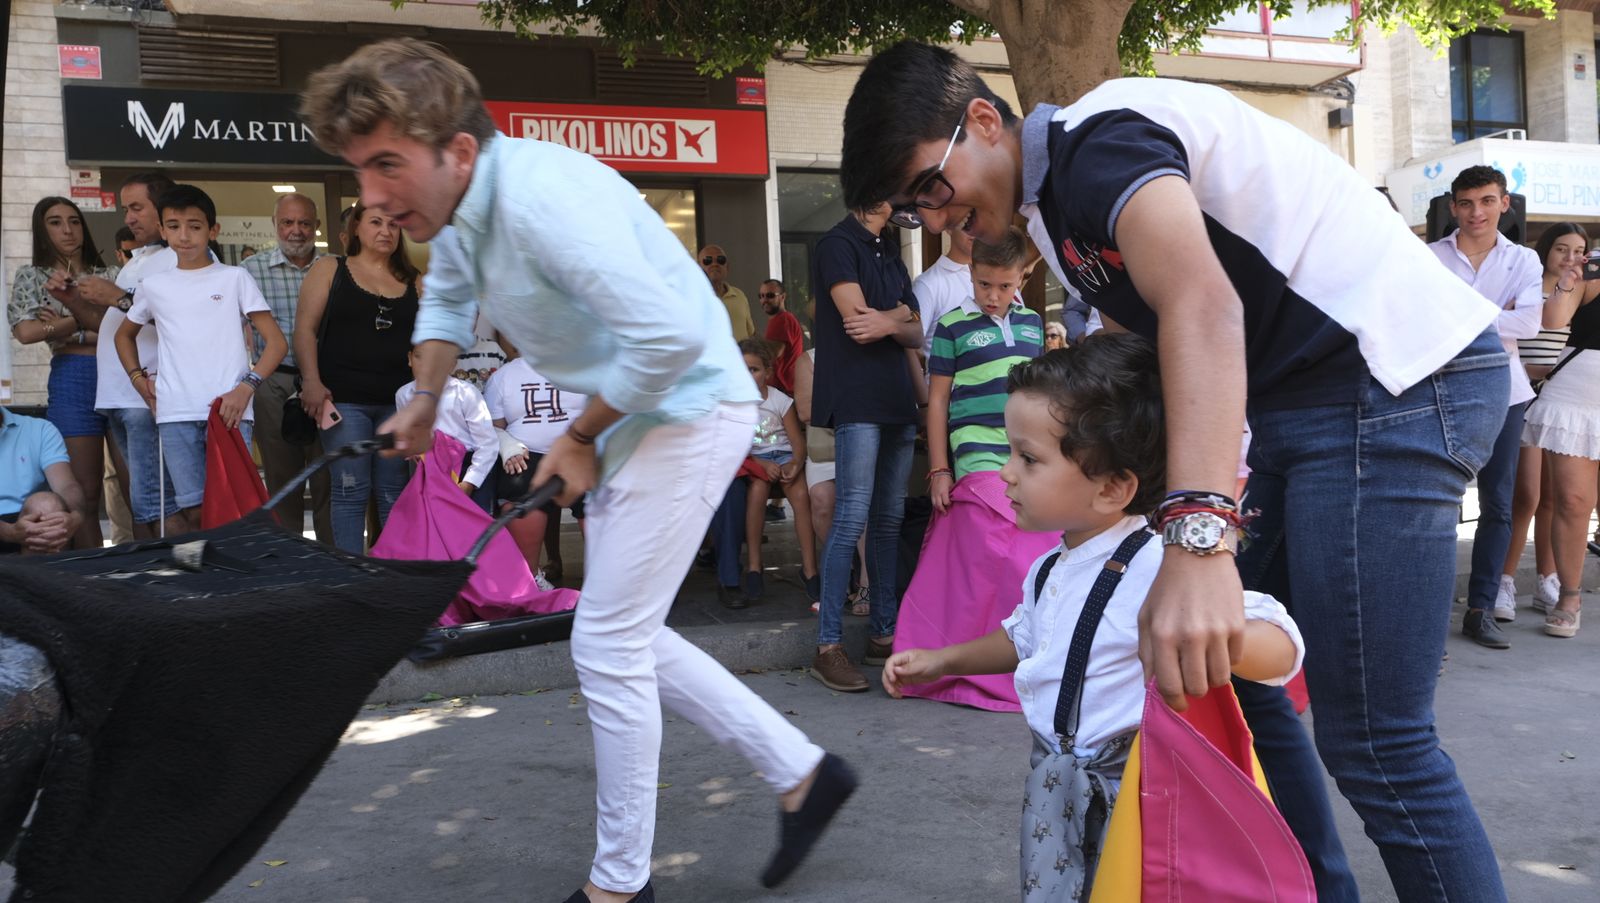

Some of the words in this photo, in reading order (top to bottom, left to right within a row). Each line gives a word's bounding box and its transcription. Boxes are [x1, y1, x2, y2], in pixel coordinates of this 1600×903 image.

[522, 118, 668, 158] PIKOLINOS
[1532, 183, 1568, 205] DEL
[1572, 184, 1600, 206] PIN
